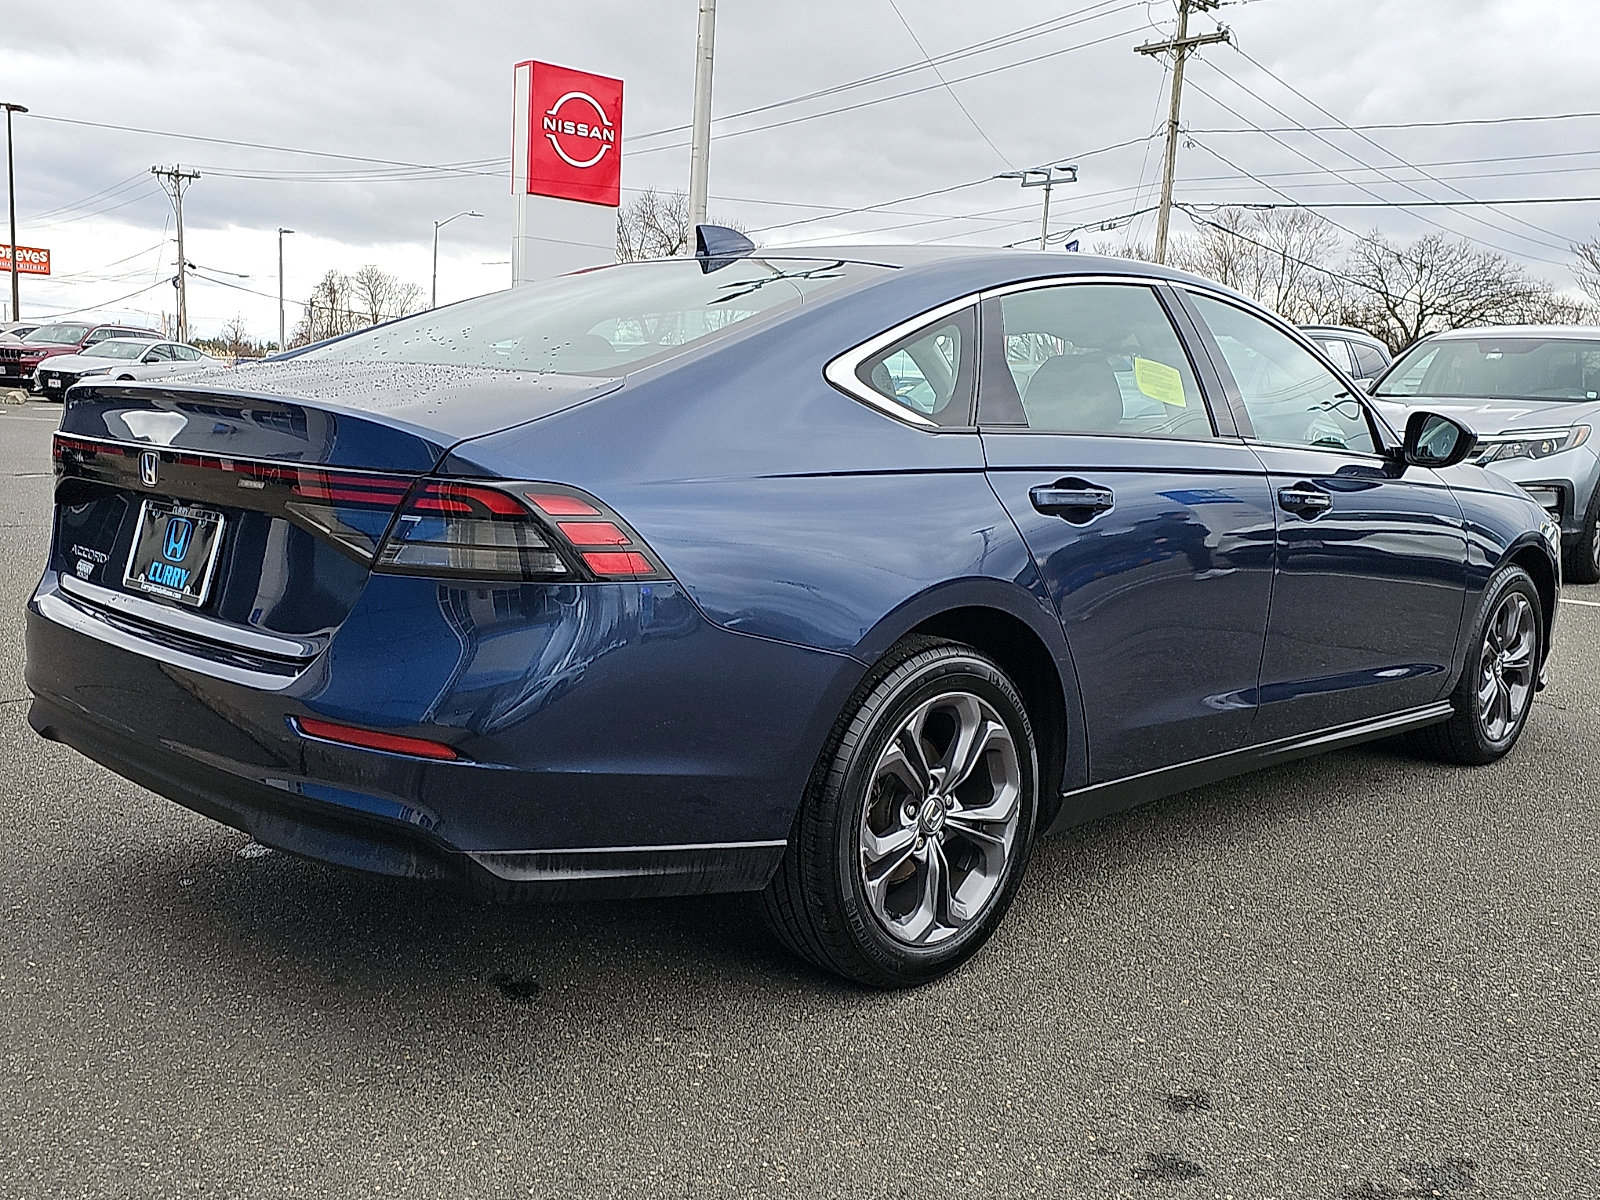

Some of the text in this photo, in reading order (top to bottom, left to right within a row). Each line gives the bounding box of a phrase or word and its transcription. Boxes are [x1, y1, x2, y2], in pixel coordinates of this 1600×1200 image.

[543, 116, 615, 143] NISSAN
[71, 543, 108, 563] ACCORD
[148, 561, 190, 590] CURRY
